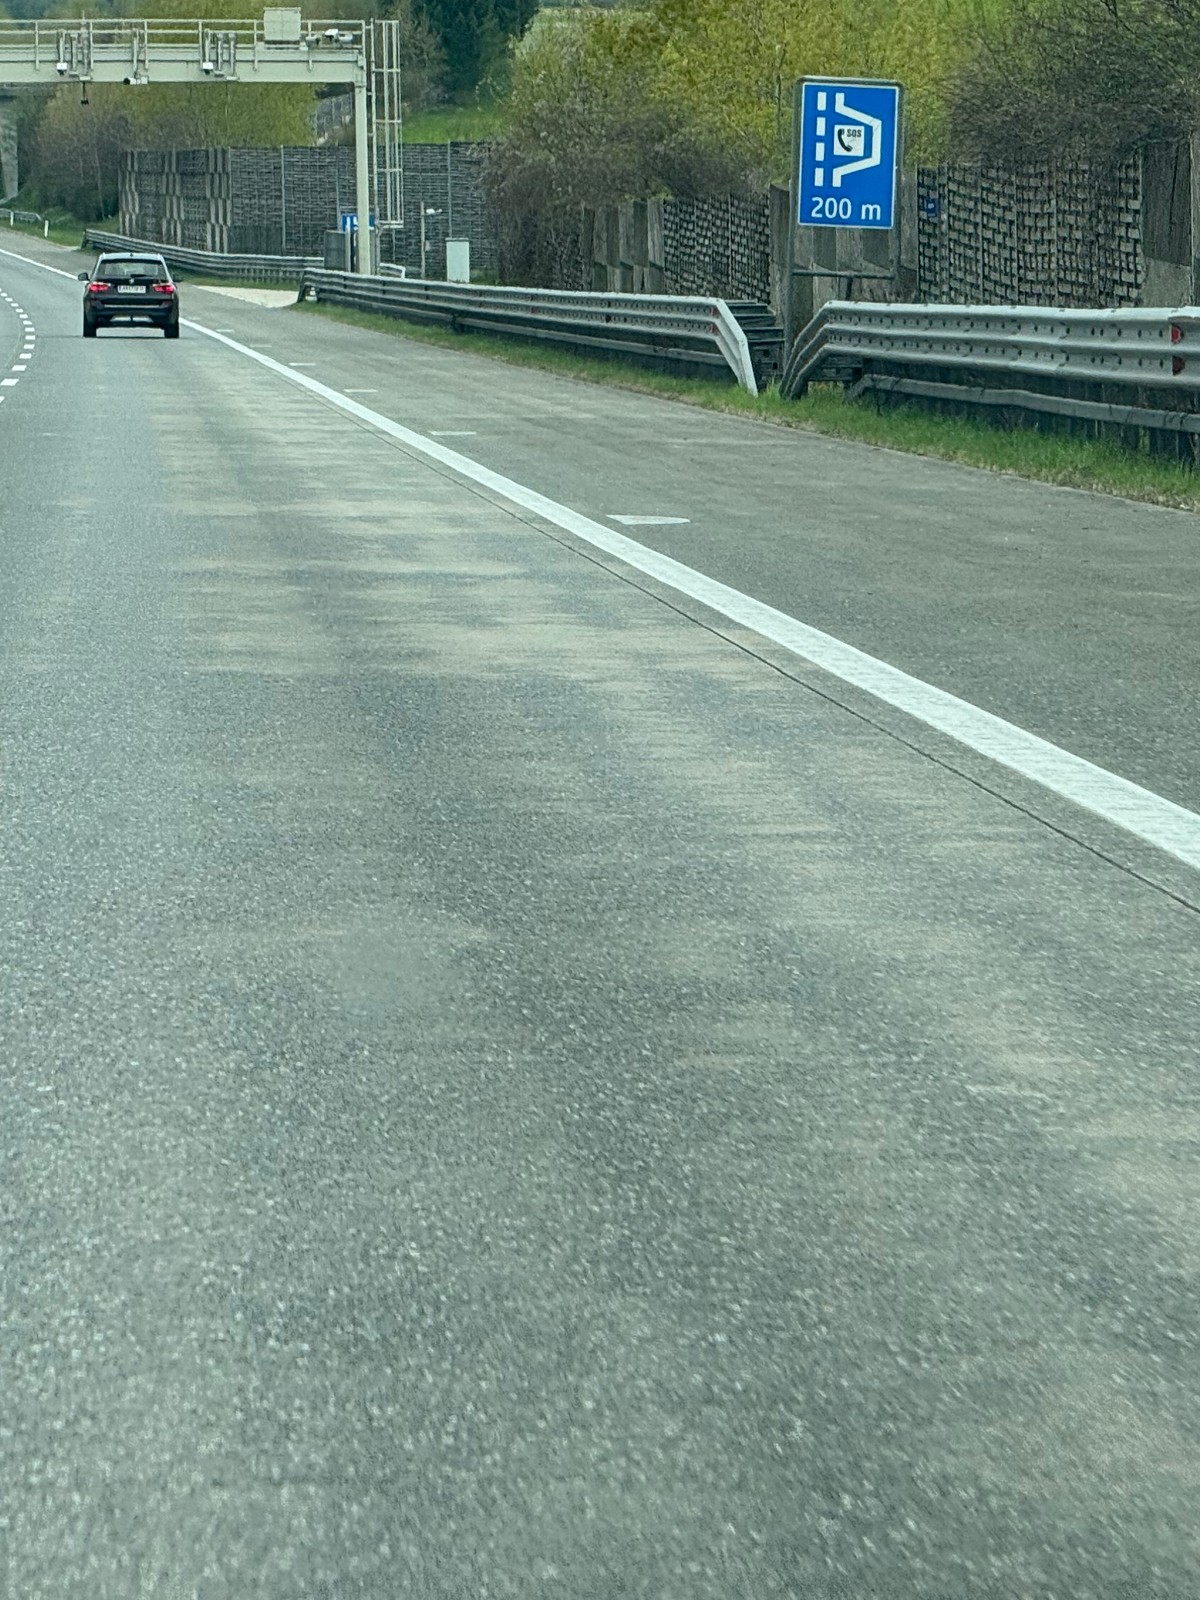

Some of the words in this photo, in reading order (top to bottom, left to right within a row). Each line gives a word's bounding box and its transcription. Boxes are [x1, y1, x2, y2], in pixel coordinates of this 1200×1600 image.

[846, 129, 862, 138] SOS
[811, 196, 852, 219] 200
[861, 203, 881, 220] m
